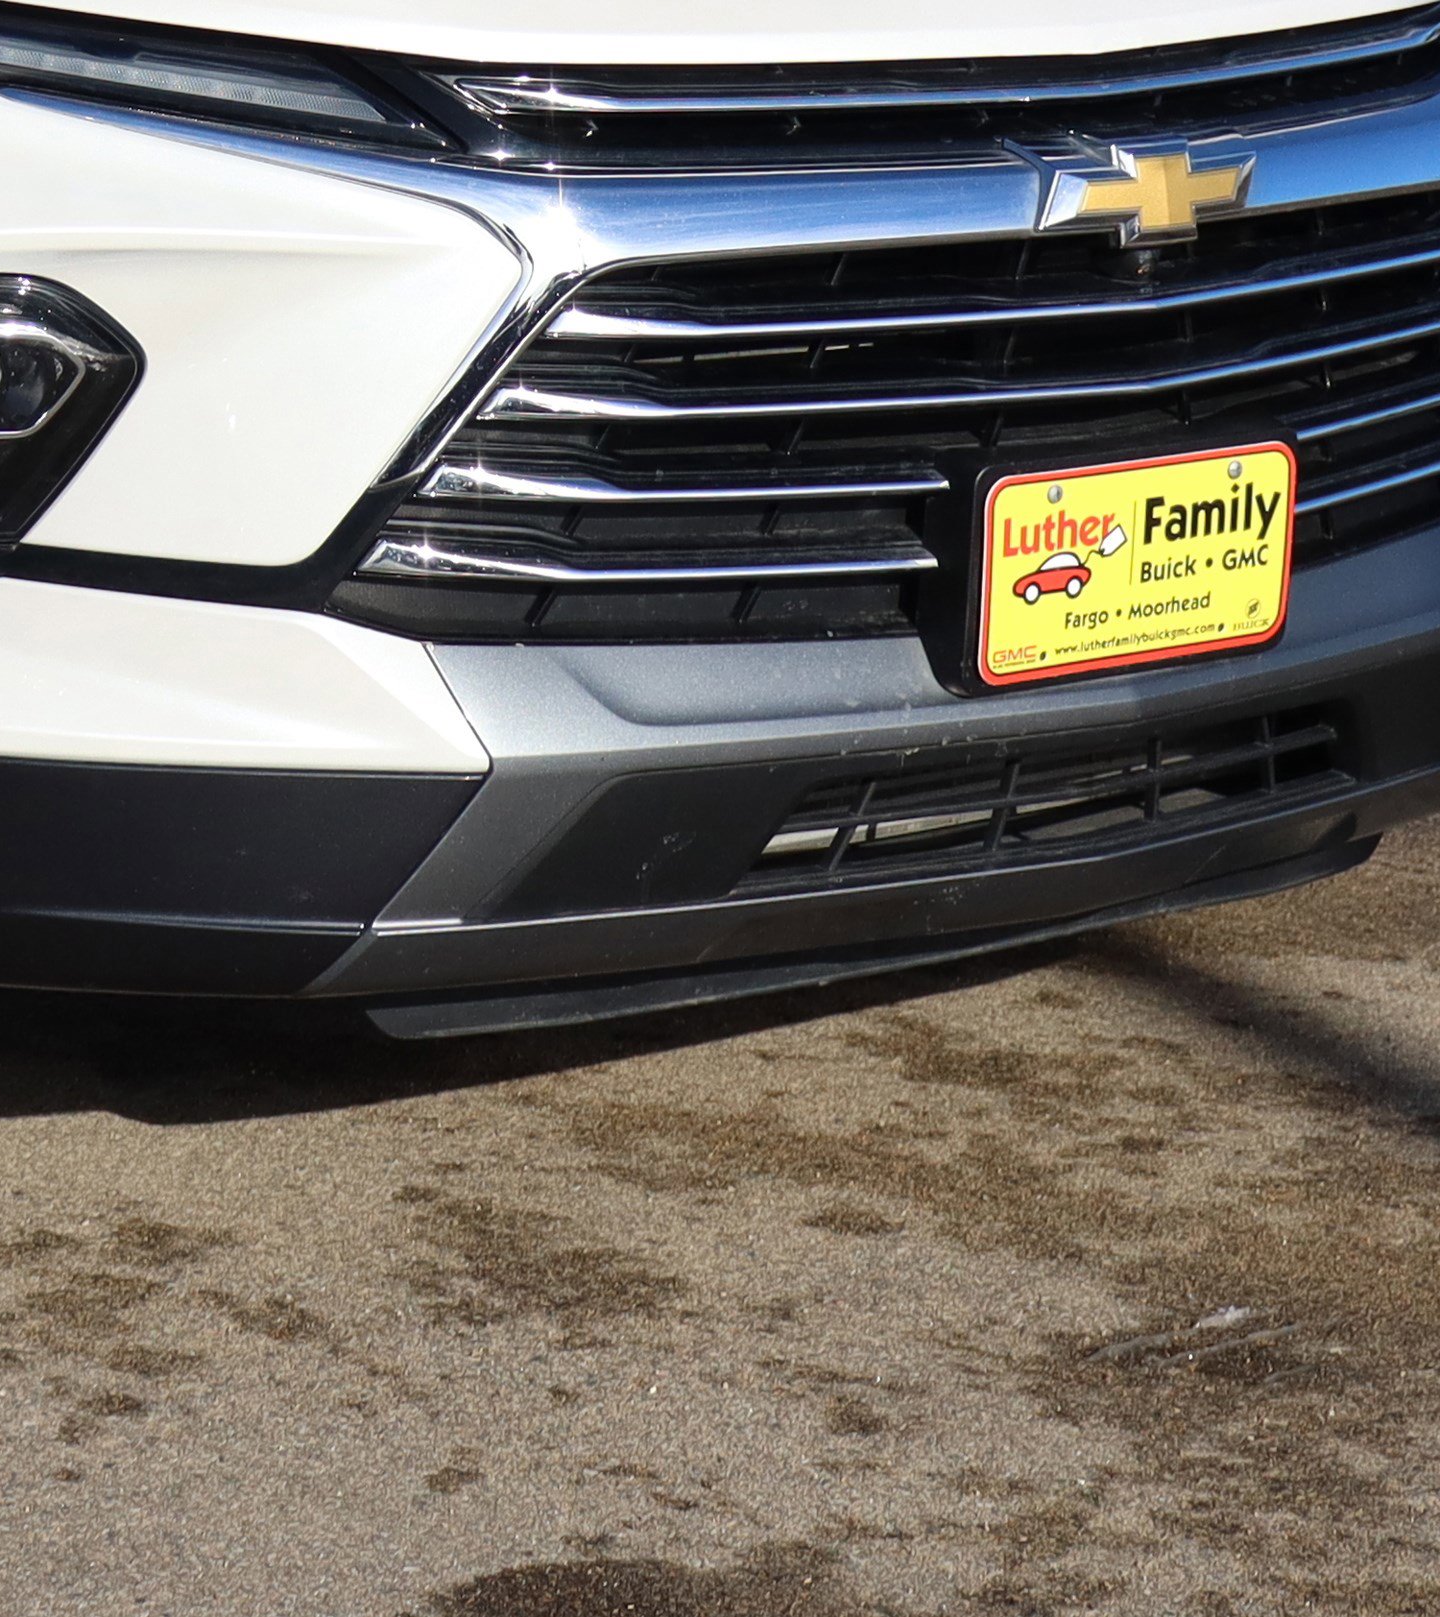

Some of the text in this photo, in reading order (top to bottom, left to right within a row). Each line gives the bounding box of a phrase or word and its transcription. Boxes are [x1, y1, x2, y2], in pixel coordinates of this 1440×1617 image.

[1143, 482, 1281, 545] Family
[1003, 509, 1116, 558] Luther
[1140, 544, 1269, 583] Buick GMC
[1064, 591, 1211, 630] Fargo Moorhead
[992, 645, 1037, 664] GMC
[1054, 623, 1216, 655] www.lutherfamilybuickgmc.com
